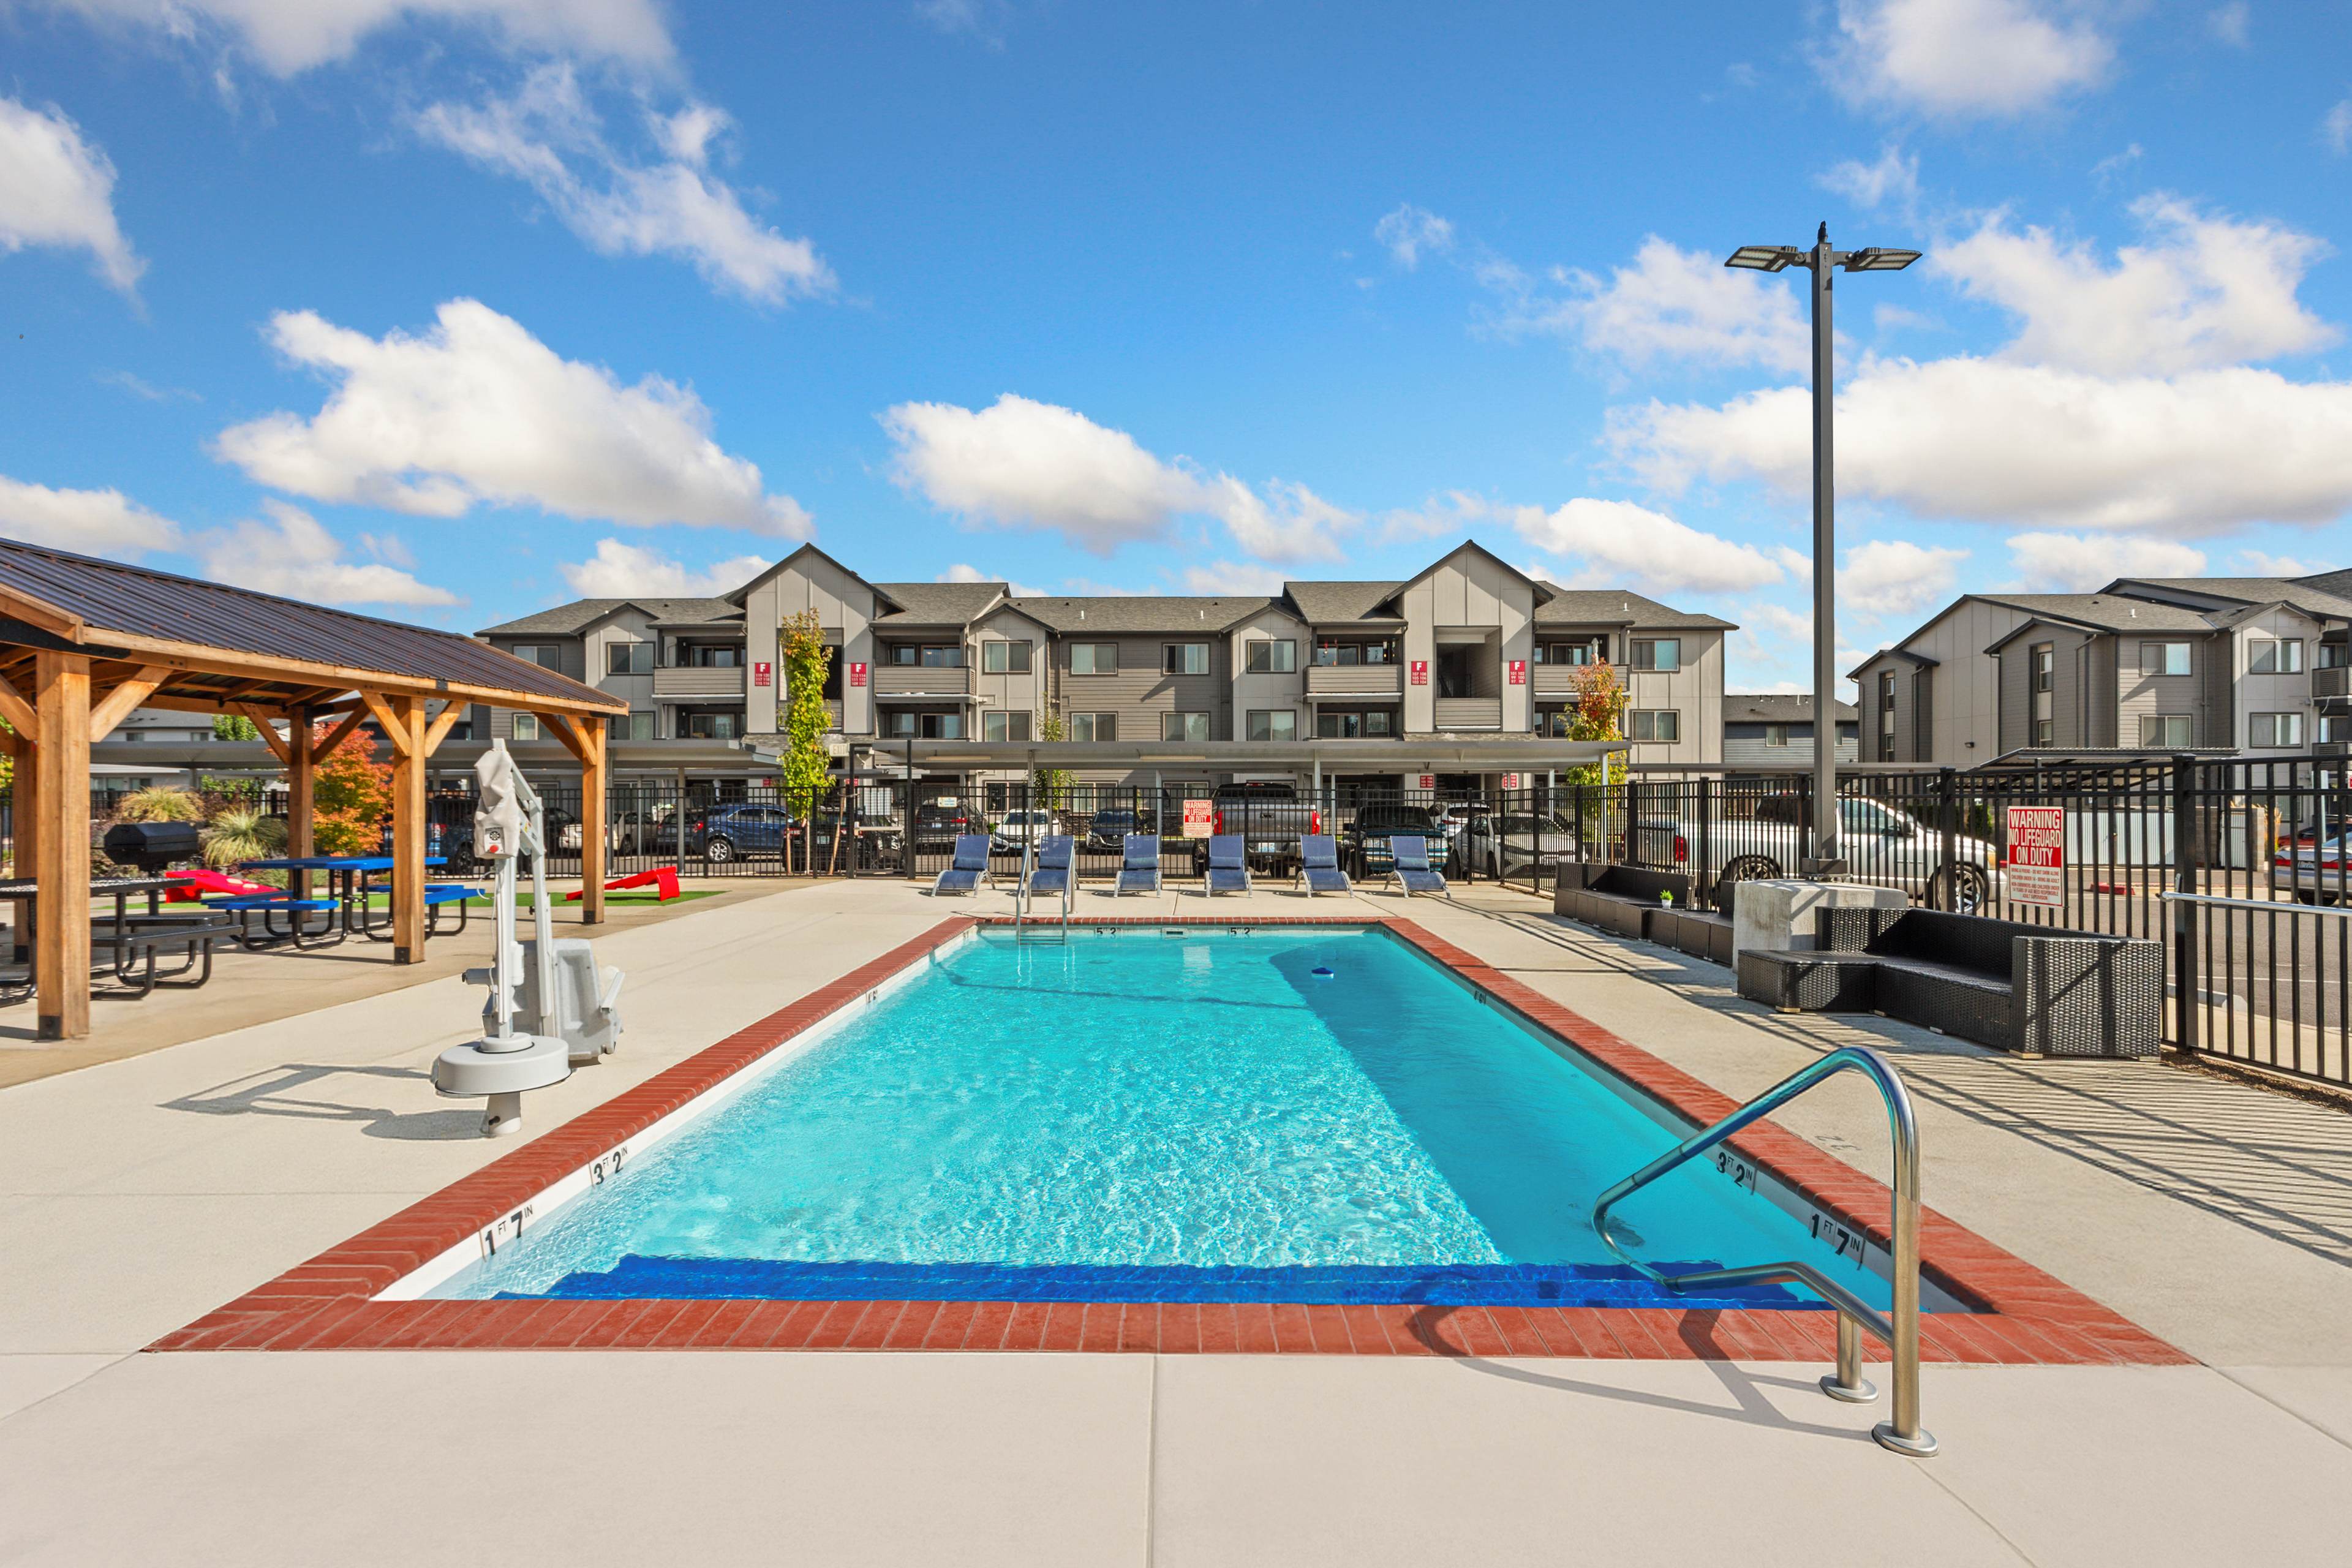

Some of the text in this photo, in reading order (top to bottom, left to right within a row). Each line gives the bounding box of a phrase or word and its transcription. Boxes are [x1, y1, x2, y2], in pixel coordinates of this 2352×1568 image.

[1417, 662, 1422, 671] F
[1515, 662, 1520, 670] F
[2010, 810, 2060, 829] WARNING
[2010, 828, 2061, 848] NO LIFEGUARD
[2016, 846, 2053, 866] ON DUTY
[594, 1146, 628, 1185] 3 FT 2 IN
[1716, 1152, 1753, 1188] 3 FT 2 IN
[485, 1205, 533, 1256] 1 FT 7 IN
[1811, 1213, 1860, 1256] 1 FT 7 IN
